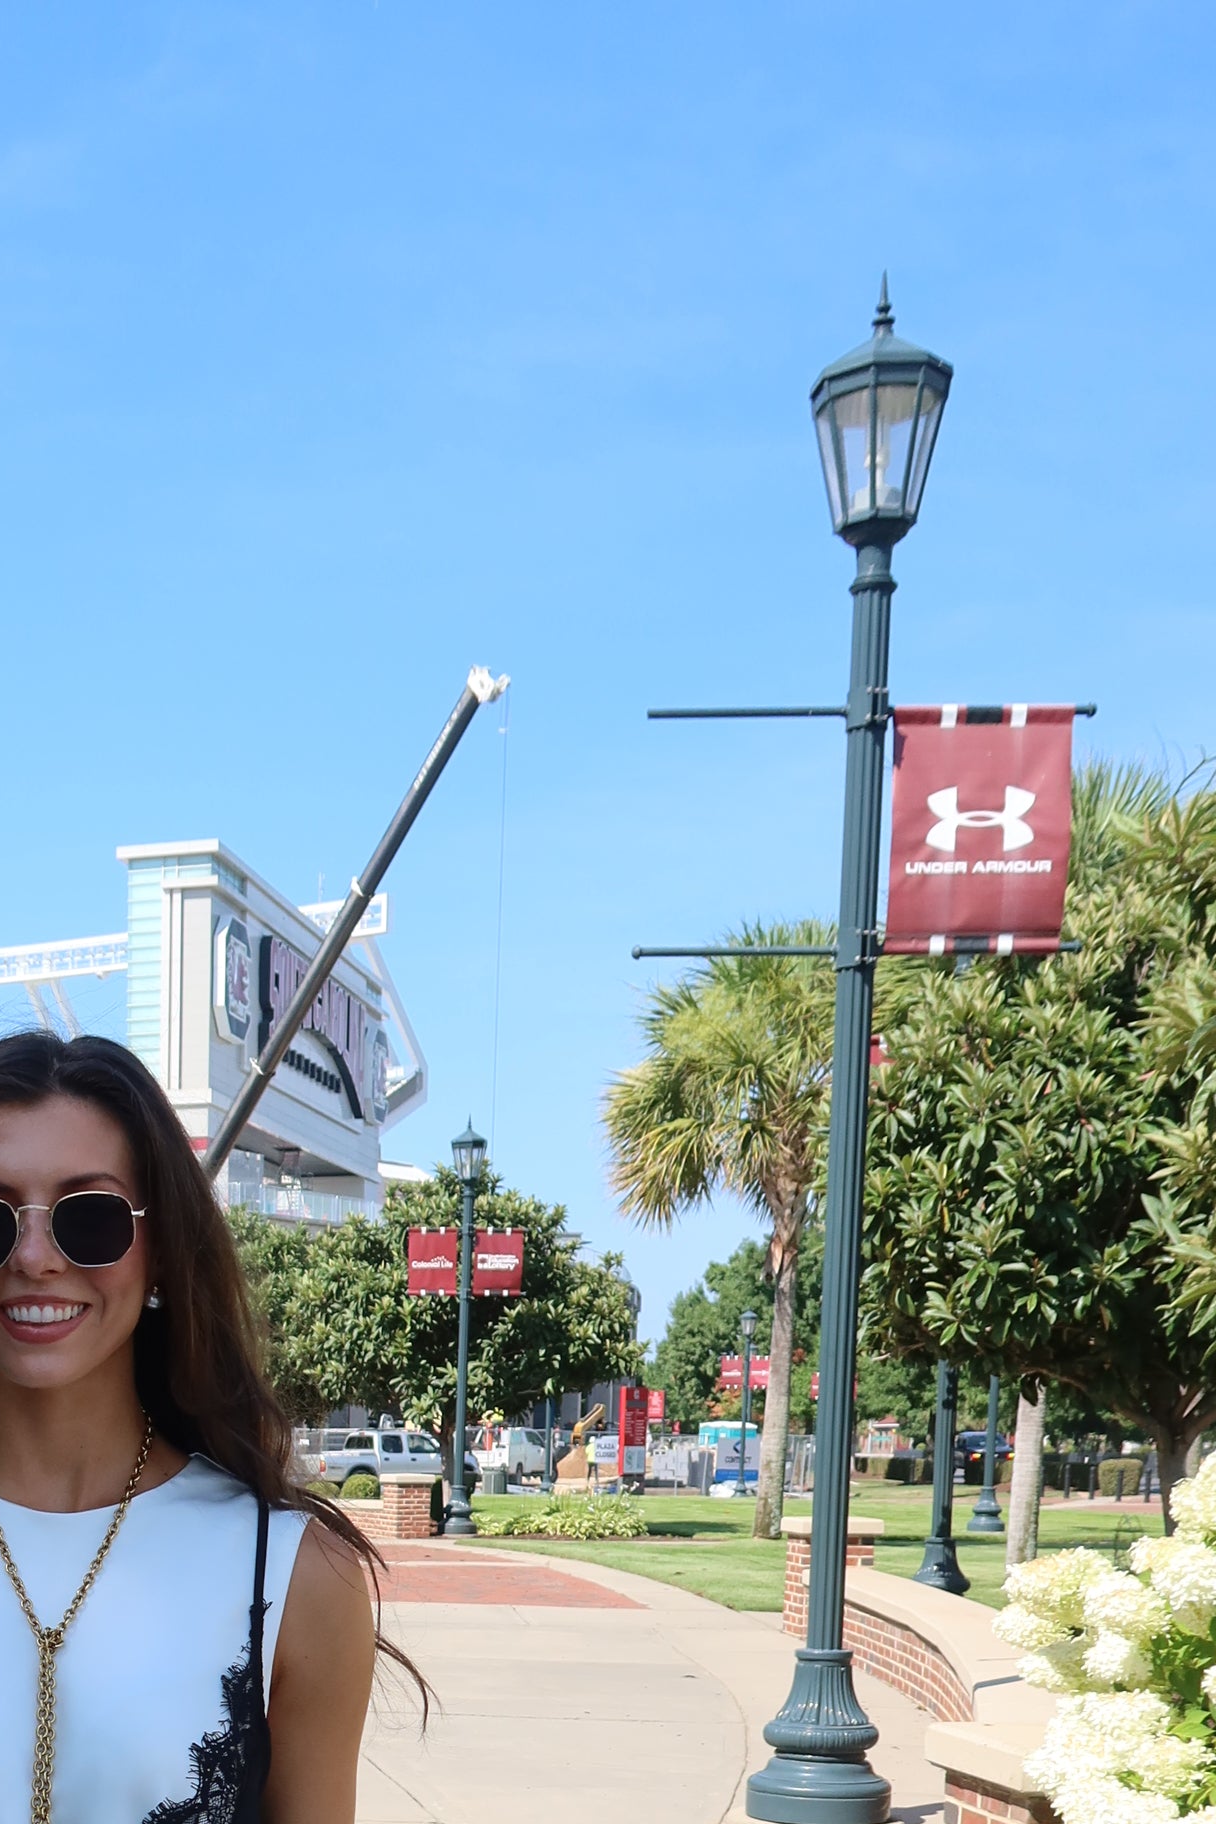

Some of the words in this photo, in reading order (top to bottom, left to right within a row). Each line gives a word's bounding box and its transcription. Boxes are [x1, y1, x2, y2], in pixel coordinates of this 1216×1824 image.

[905, 861, 967, 874] UNDER
[971, 860, 1052, 874] ARMOUR
[411, 1260, 440, 1268] Colonial
[441, 1260, 454, 1268] Life
